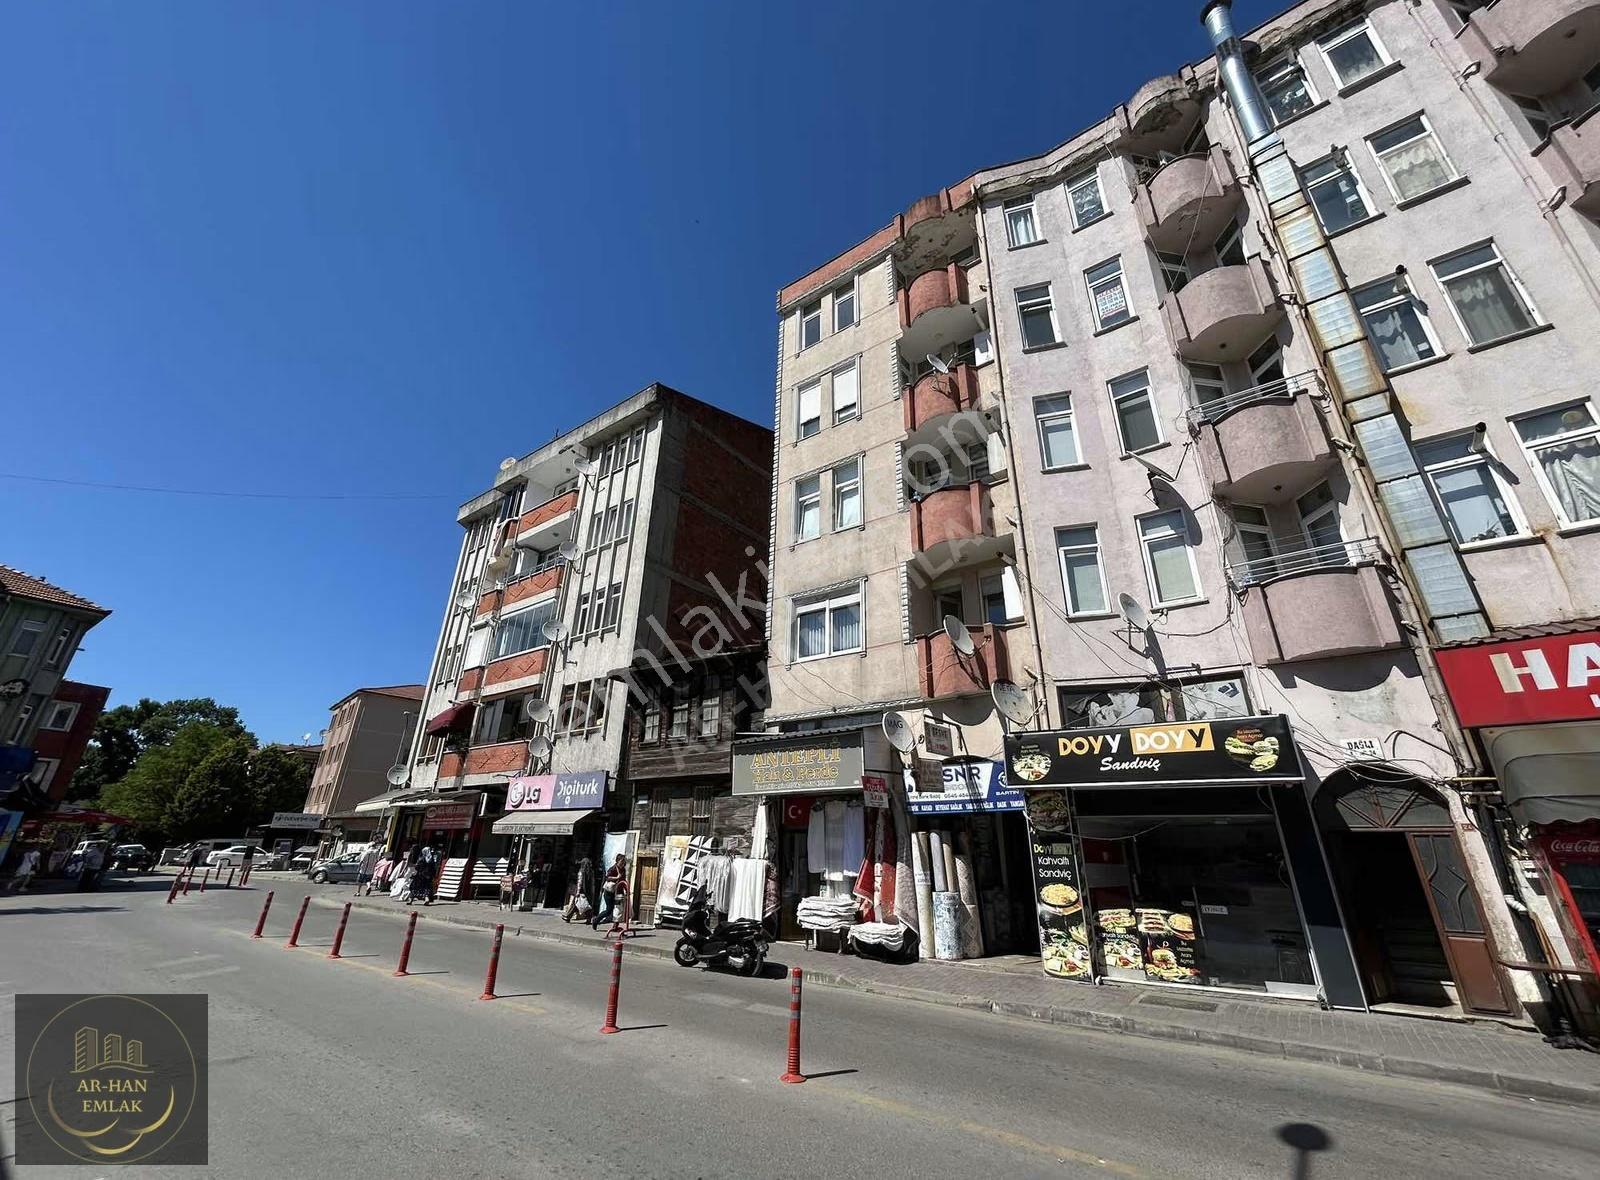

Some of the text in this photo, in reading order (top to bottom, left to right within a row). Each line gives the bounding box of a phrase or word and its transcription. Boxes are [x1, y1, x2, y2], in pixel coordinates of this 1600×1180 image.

[1058, 728, 1207, 756] DOYY DOYY
[782, 766, 794, 781] &
[796, 763, 839, 781] Perde
[1099, 756, 1162, 772] Sandviç
[526, 785, 541, 804] LG
[1038, 868, 1072, 881] Sandviç
